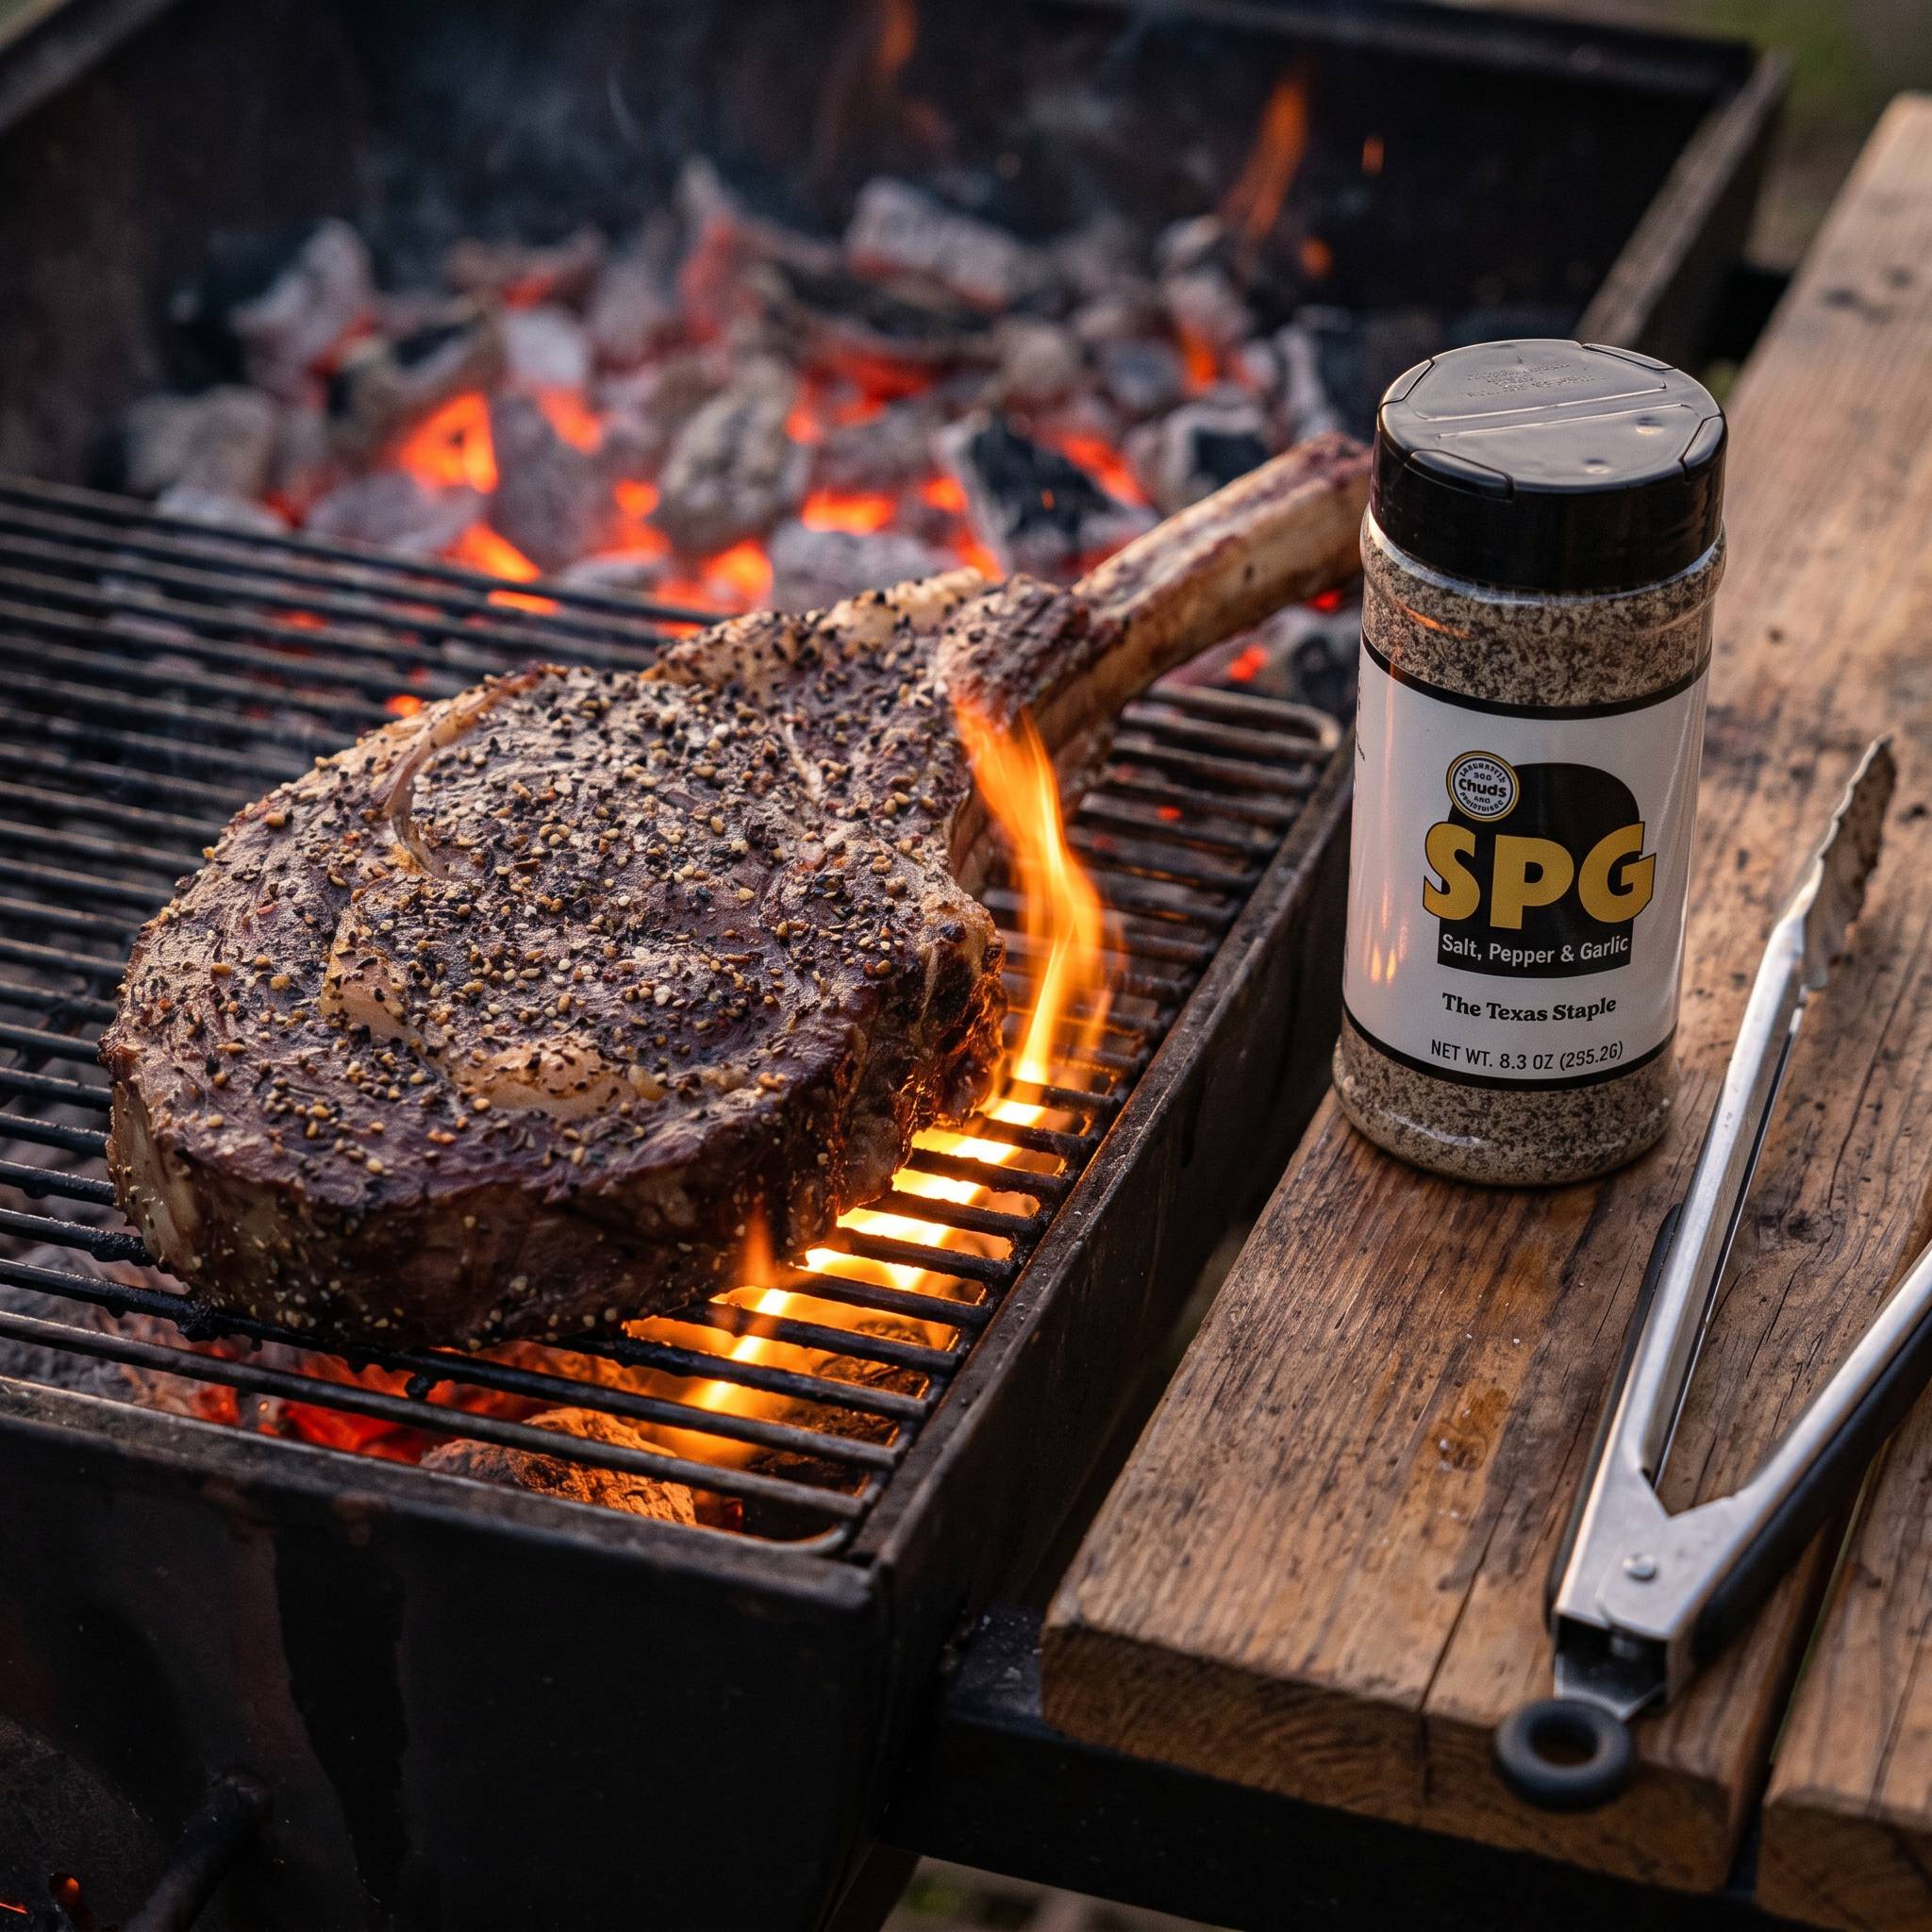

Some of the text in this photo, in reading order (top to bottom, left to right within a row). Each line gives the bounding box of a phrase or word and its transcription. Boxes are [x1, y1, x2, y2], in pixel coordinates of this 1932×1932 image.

[1458, 778, 1507, 798] Chuds
[1423, 822, 1657, 929] SPG
[1441, 934, 1628, 967] Salt, Pepper & Garlic
[1442, 992, 1617, 1022] The Texas Staple
[1431, 1039, 1460, 1061] NET
[1465, 1047, 1493, 1067] WT.
[1499, 1053, 1526, 1070] 8.3
[1533, 1054, 1555, 1070] OZ
